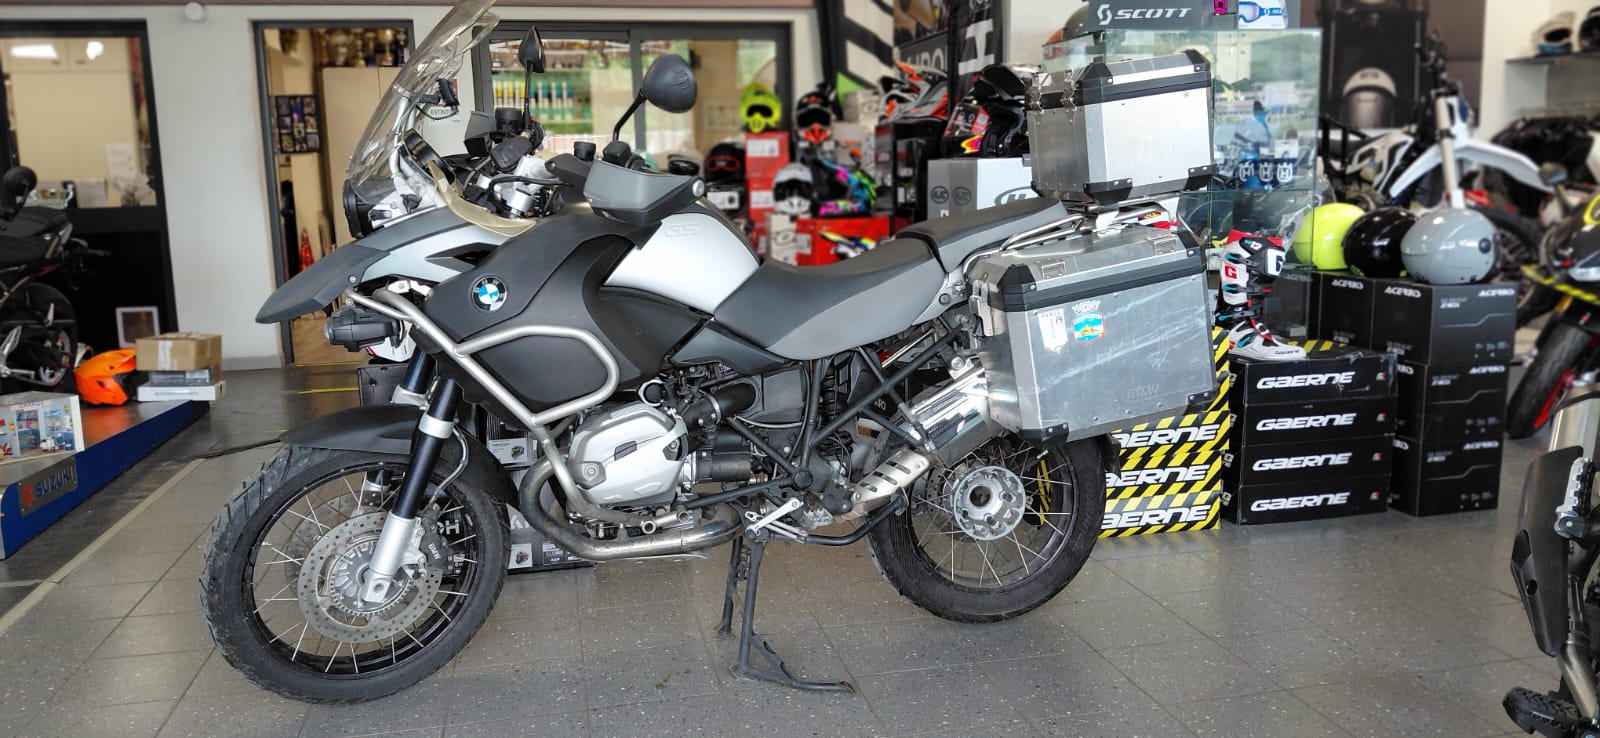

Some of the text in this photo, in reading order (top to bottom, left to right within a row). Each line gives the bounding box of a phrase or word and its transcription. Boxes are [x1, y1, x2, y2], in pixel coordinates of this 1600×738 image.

[1114, 7, 1192, 19] SCOTT
[1256, 371, 1356, 390] GAERNE
[1256, 412, 1357, 431] GAERNE
[1252, 452, 1353, 471] GAERNE
[35, 467, 74, 497] SUZUKI
[1250, 492, 1351, 512] GAERNE
[427, 542, 441, 561] BMW
